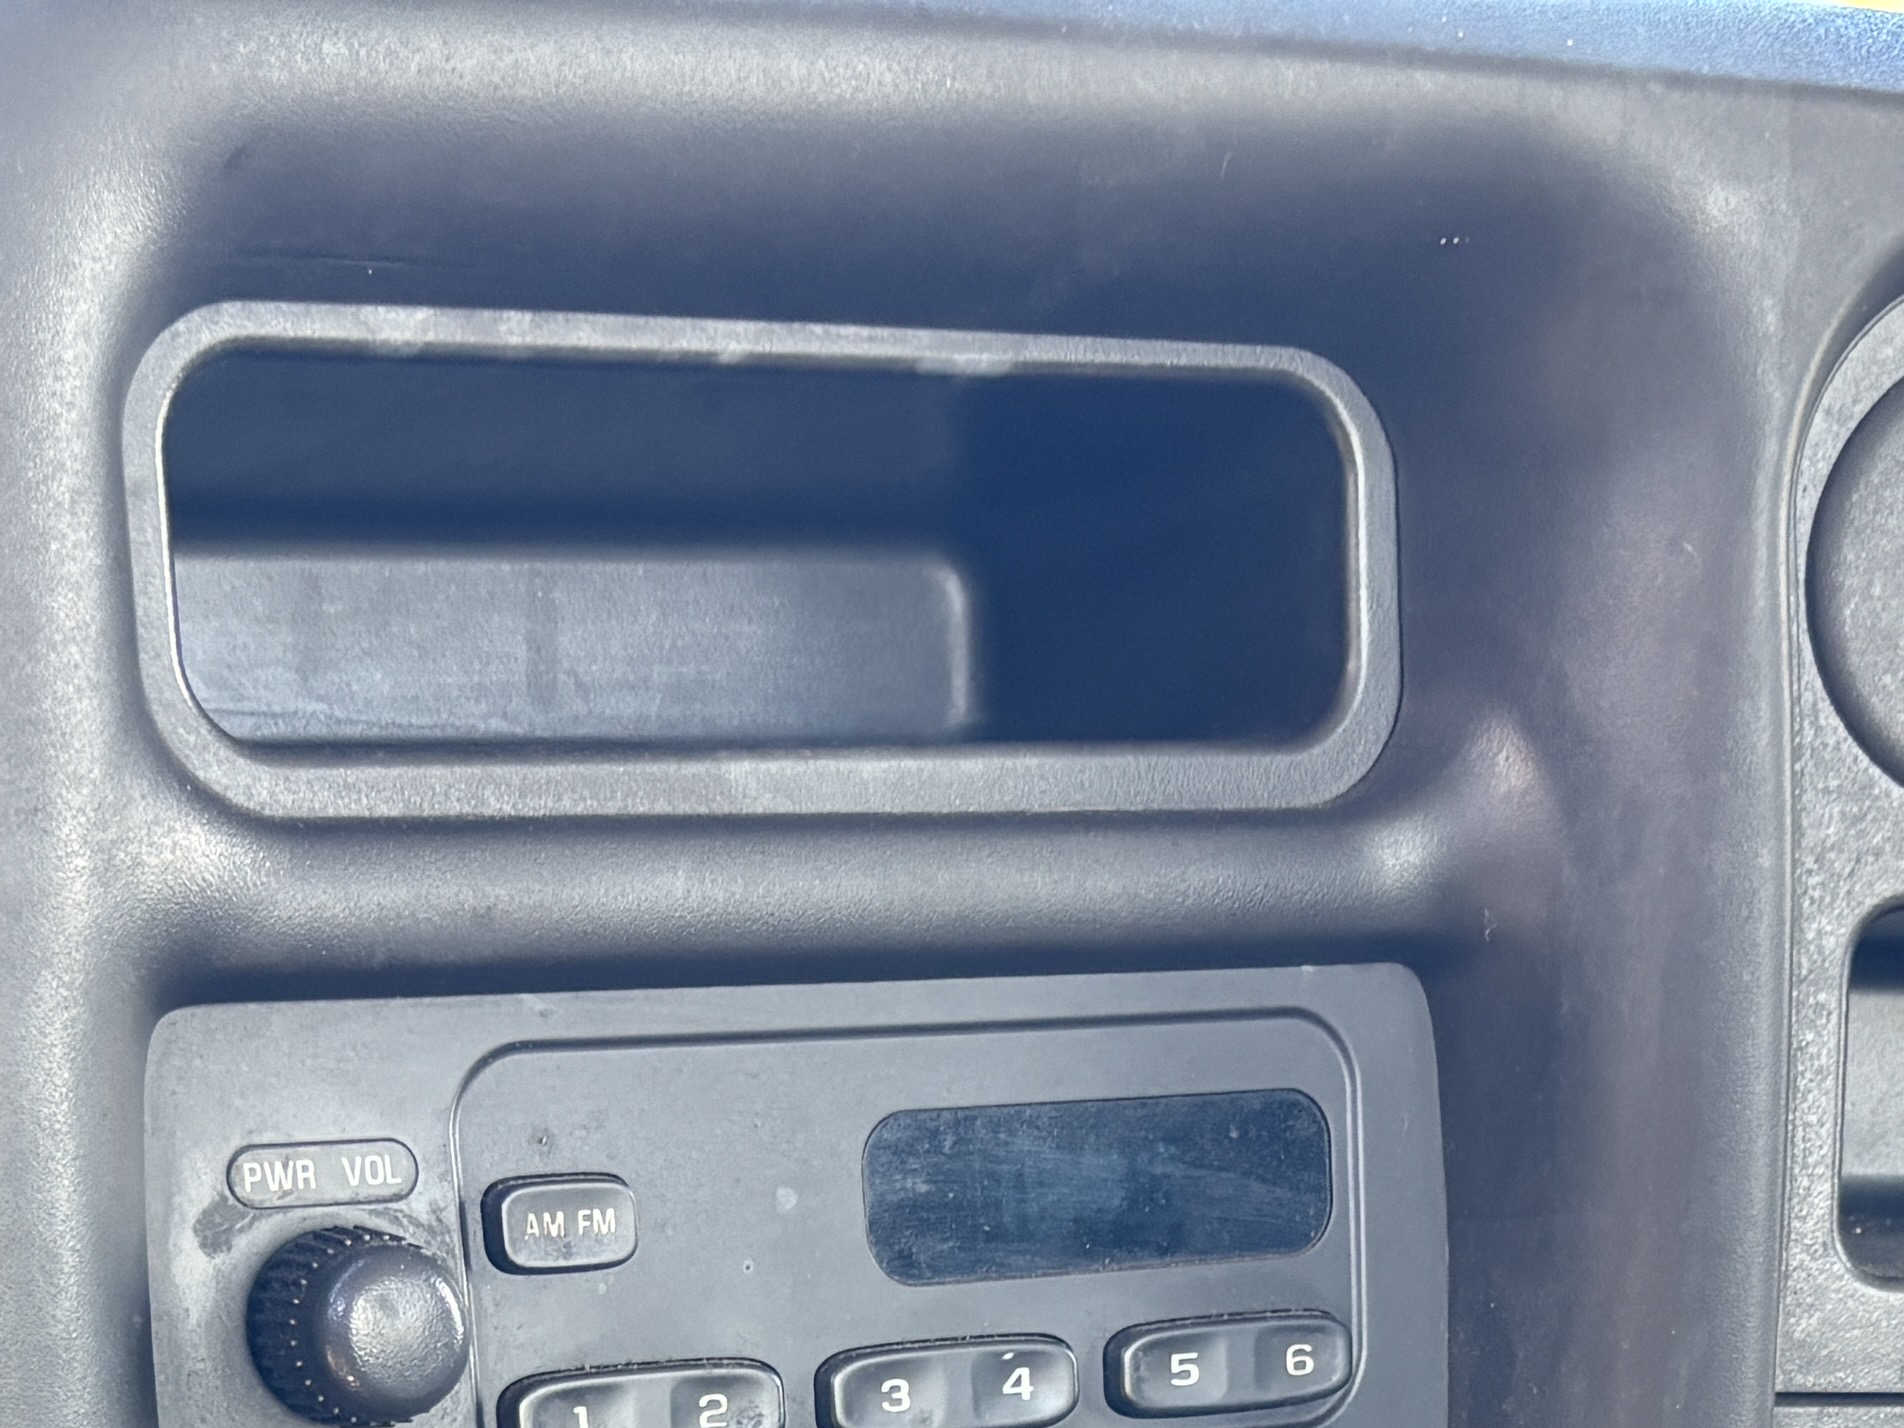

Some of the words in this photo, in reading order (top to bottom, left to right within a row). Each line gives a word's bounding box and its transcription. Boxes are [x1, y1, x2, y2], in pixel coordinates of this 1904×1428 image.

[242, 1158, 318, 1193] PWR
[341, 1154, 403, 1188] VOL
[524, 1209, 566, 1241] AM
[577, 1207, 617, 1237] FM
[698, 1392, 730, 1428] 2
[880, 1378, 911, 1413] 3
[1002, 1366, 1034, 1401] 4
[1170, 1352, 1200, 1387] 5
[1285, 1343, 1315, 1377] 6
